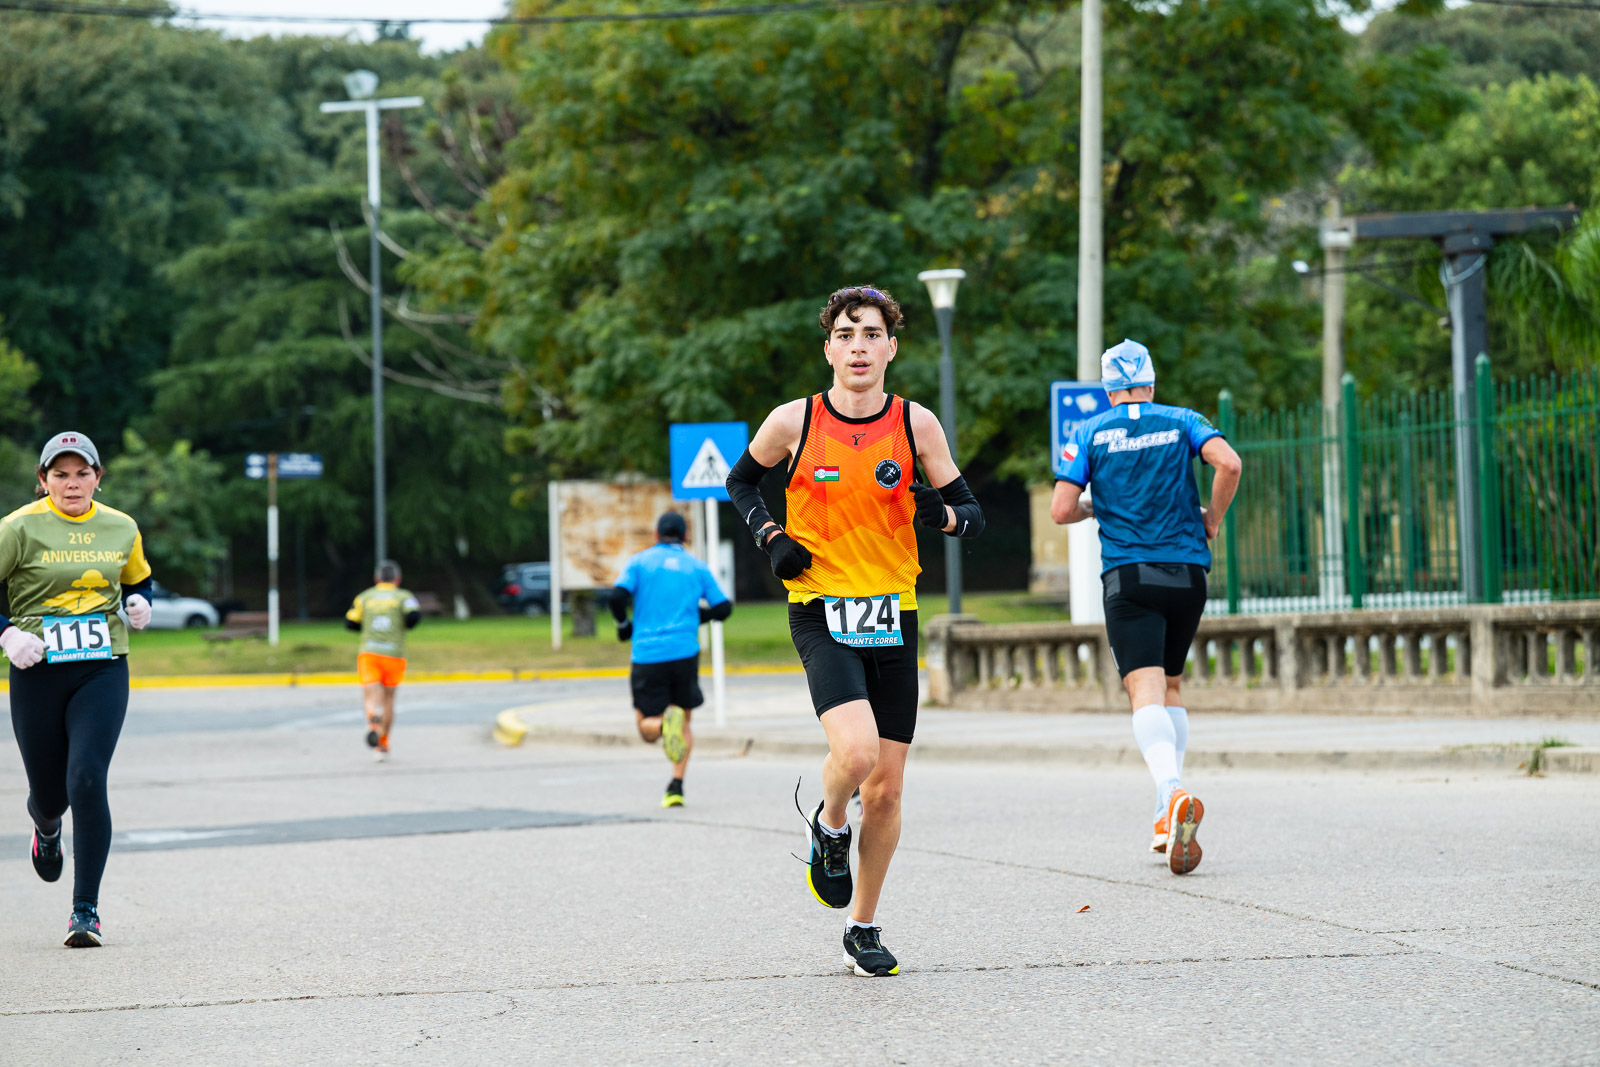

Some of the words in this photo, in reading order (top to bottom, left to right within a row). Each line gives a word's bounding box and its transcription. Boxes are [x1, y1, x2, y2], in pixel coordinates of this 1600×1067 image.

[1093, 428, 1127, 446] SIN
[1108, 429, 1179, 453] LIMITES
[41, 550, 124, 563] ANIVERSARIO
[831, 595, 894, 635] 124
[50, 619, 104, 652] 115
[836, 636, 874, 646] DIAMANTE
[874, 636, 899, 645] CORRE
[50, 652, 85, 662] DIAMANTE
[85, 650, 109, 659] CORRE
